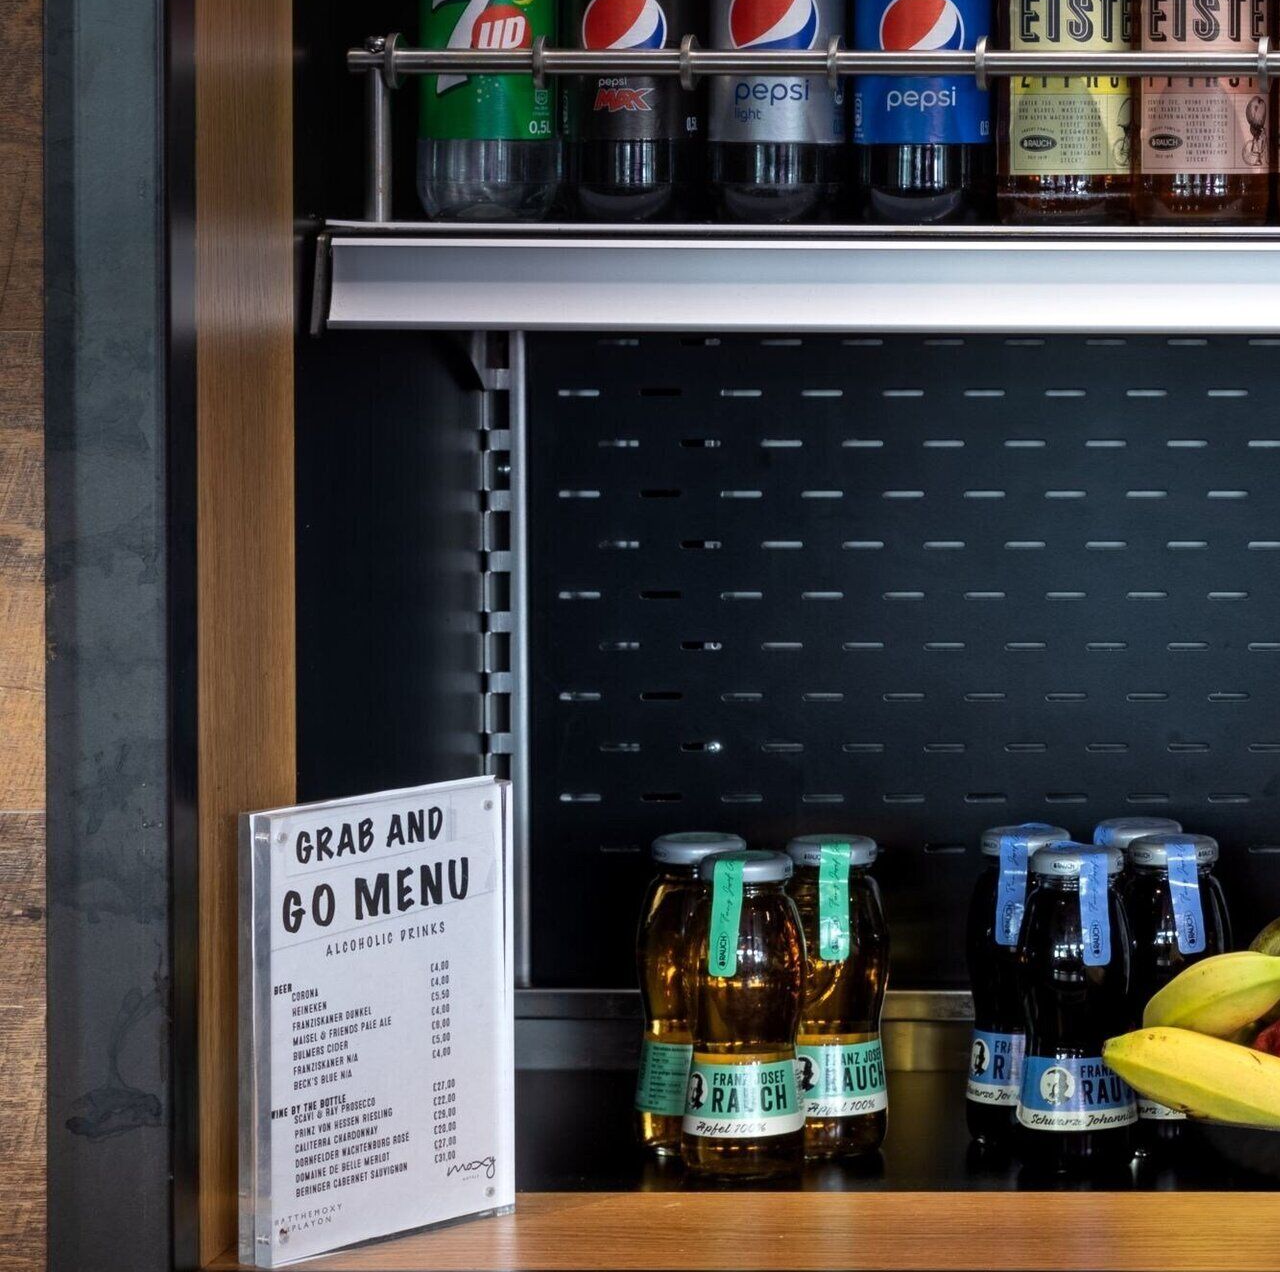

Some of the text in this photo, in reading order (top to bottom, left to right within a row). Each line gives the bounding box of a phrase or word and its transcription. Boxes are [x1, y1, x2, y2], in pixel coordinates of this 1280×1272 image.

[599, 77, 627, 87] pepsi
[735, 80, 810, 106] pepsi
[594, 88, 654, 112] MAX
[887, 86, 956, 111] pepsi
[735, 109, 761, 123] light
[296, 806, 443, 864] GRAB AND
[282, 857, 469, 934] GO MENU
[326, 921, 446, 957] ALCOHOLIC DRINKS
[293, 1032, 318, 1046] MAISEL
[329, 1024, 358, 1038] FRIENDS
[361, 1019, 377, 1032] PALE
[380, 1016, 392, 1028] ALE
